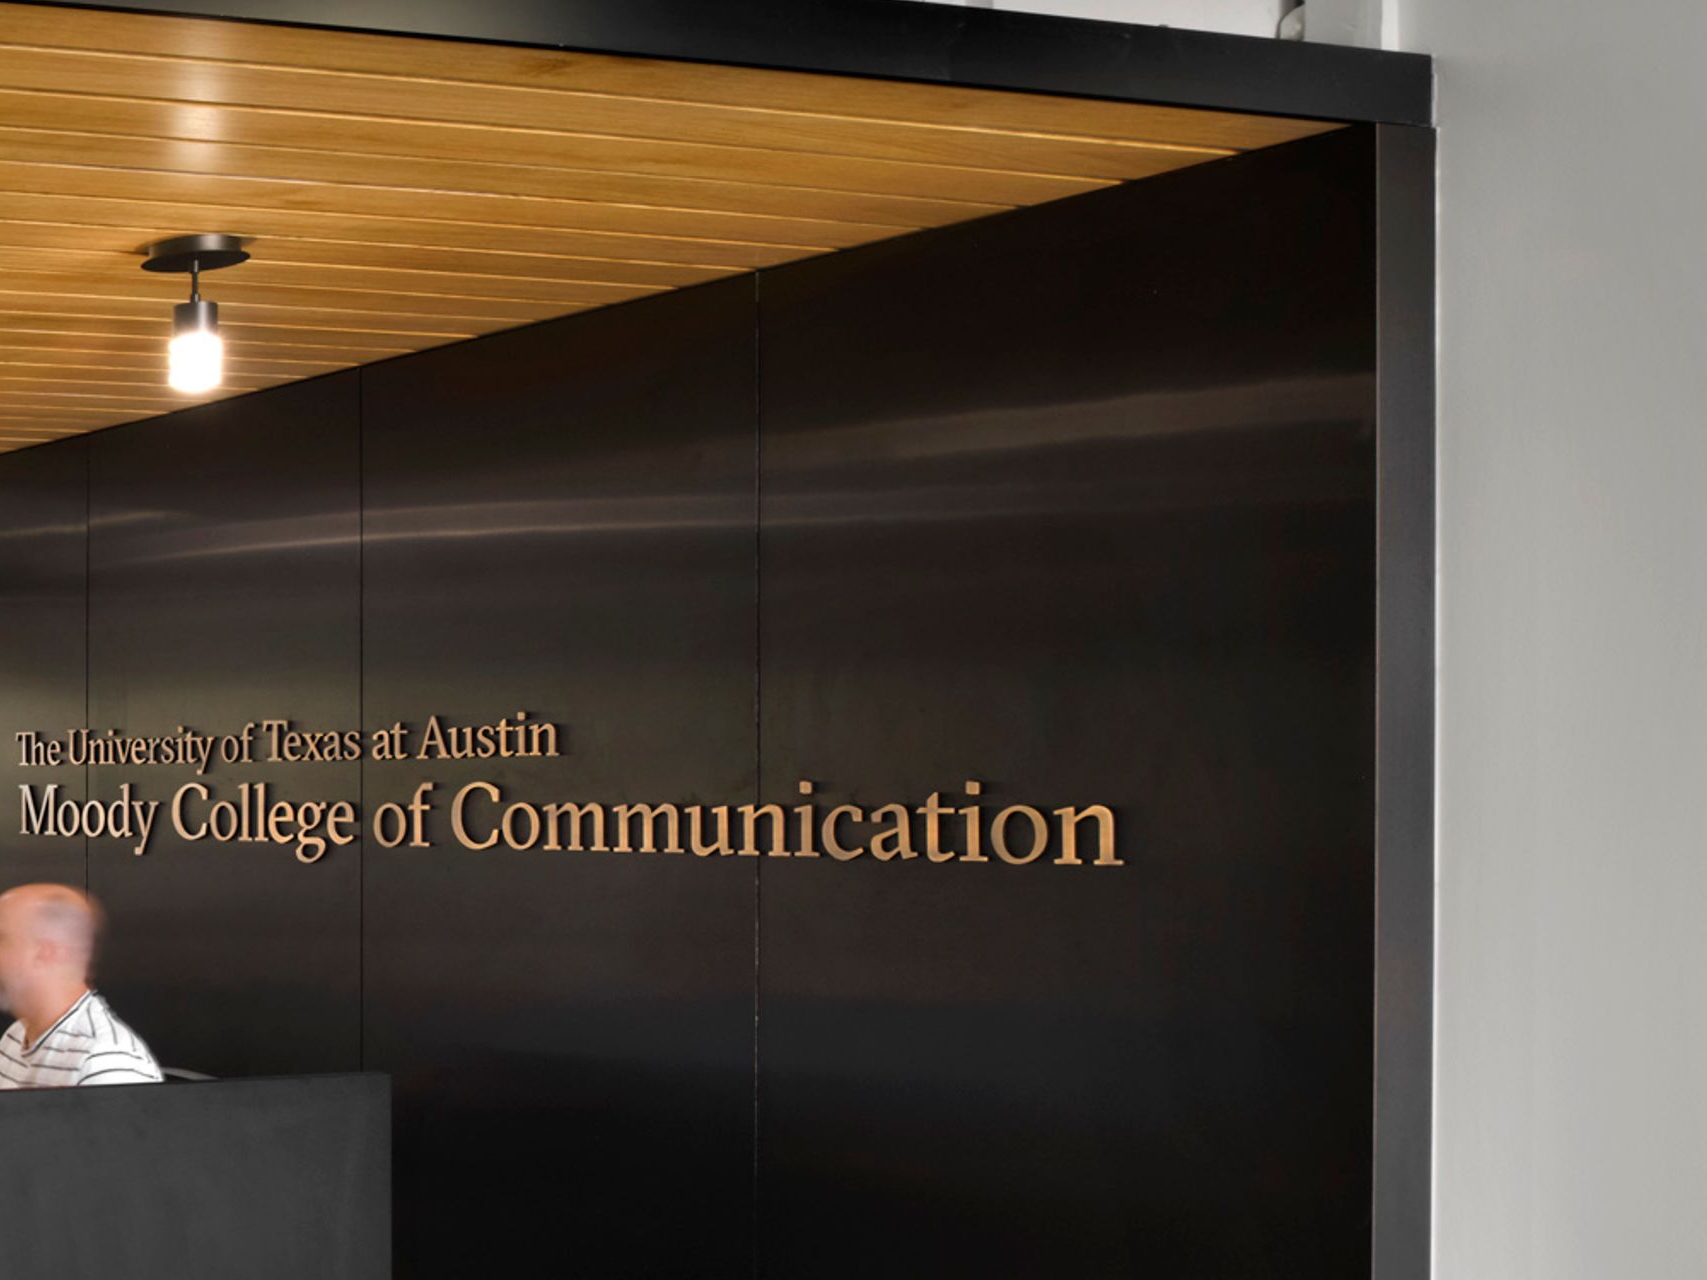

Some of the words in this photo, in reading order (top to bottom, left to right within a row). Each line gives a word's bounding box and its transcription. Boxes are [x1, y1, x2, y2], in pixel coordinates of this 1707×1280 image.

[15, 730, 62, 766] The
[67, 724, 215, 775] University
[221, 721, 255, 764] of
[261, 718, 361, 764] Texas
[372, 721, 408, 761] at
[416, 711, 560, 760] Austin
[18, 782, 160, 856] Moody
[170, 781, 355, 864] College
[372, 781, 434, 849] of
[450, 780, 1125, 867] Communication
